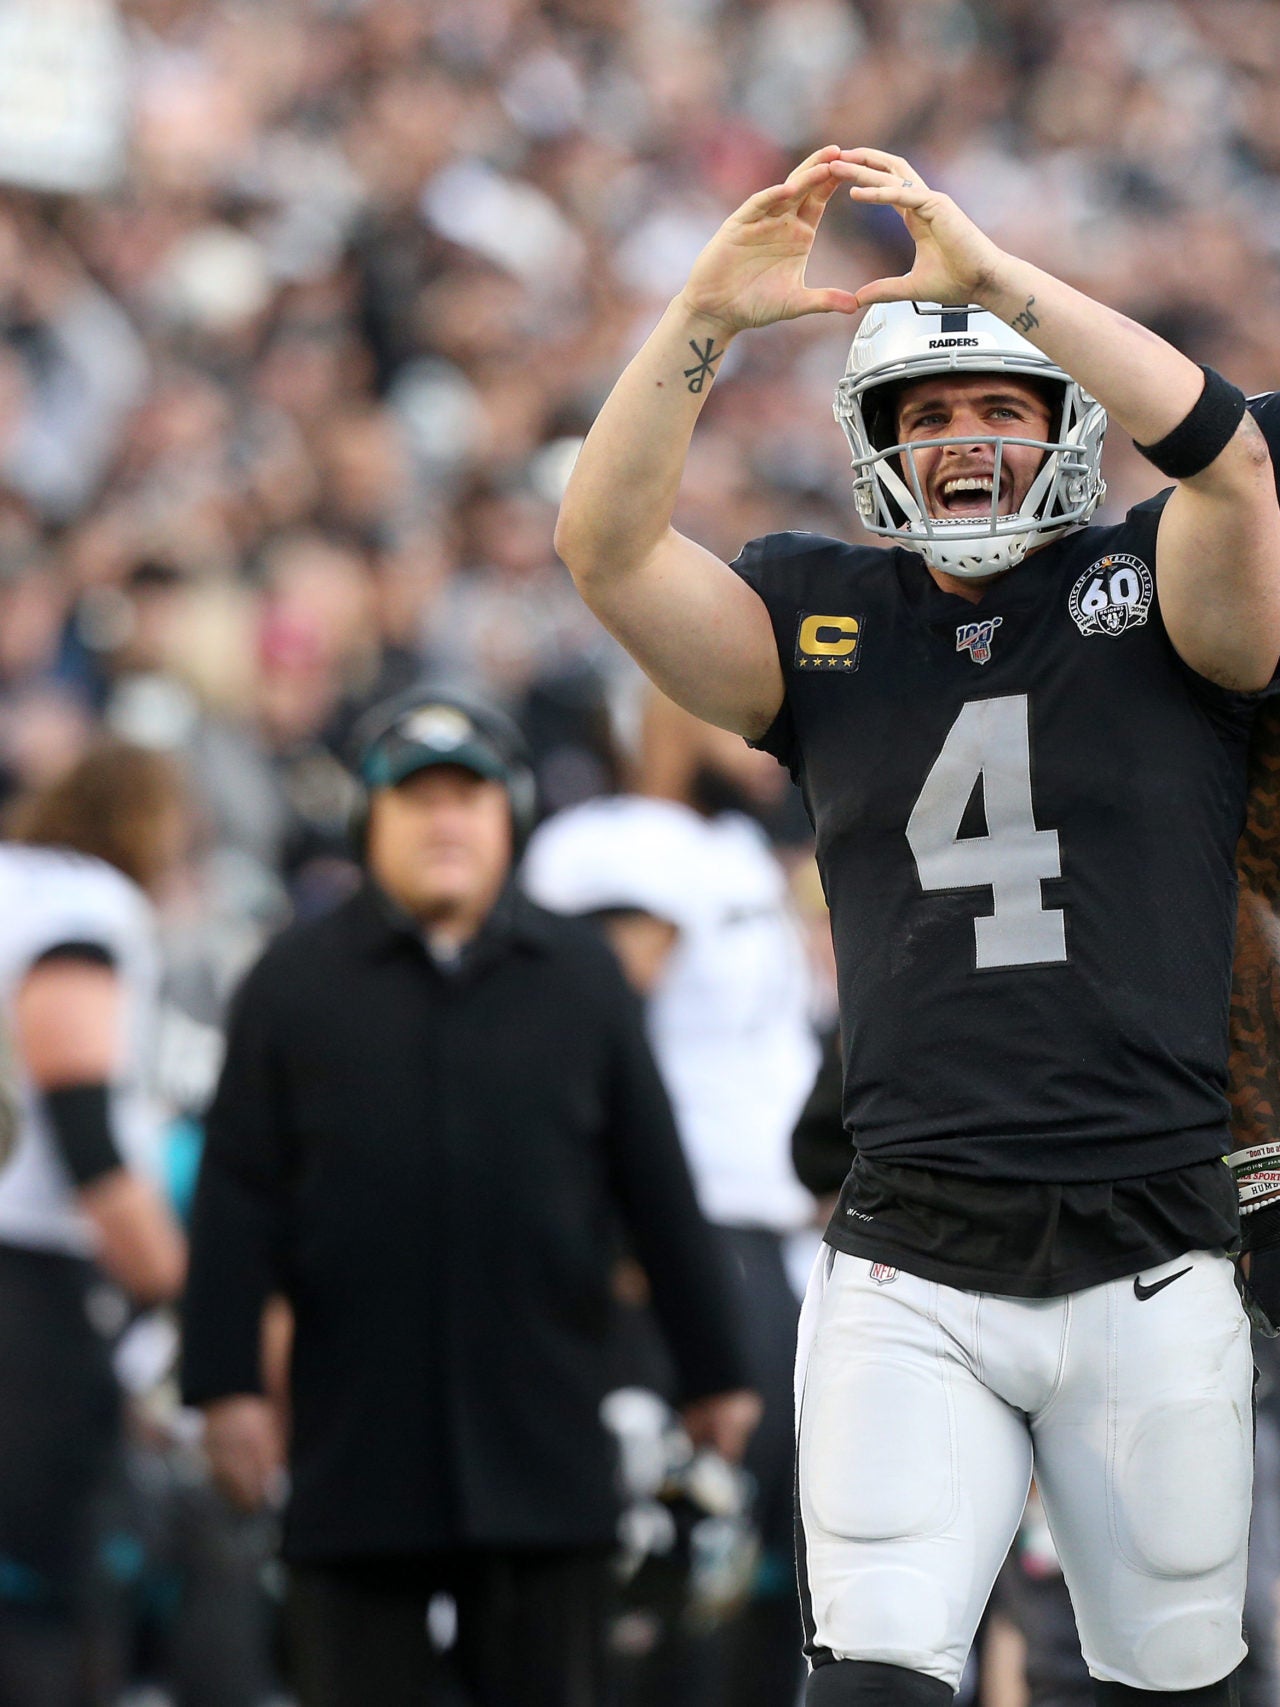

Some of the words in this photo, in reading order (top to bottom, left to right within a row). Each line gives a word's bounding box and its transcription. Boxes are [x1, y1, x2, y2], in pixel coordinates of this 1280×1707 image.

[929, 338, 979, 349] RAIDERS
[1070, 576, 1086, 621] AMERICAN
[1089, 556, 1136, 573] FOOTBALL
[1138, 564, 1151, 605] LEAGUE
[1081, 568, 1140, 617] 60
[1099, 606, 1124, 615] RAIDERS
[799, 614, 858, 656] C
[905, 694, 1067, 969] 4
[873, 1264, 892, 1279] NFL
